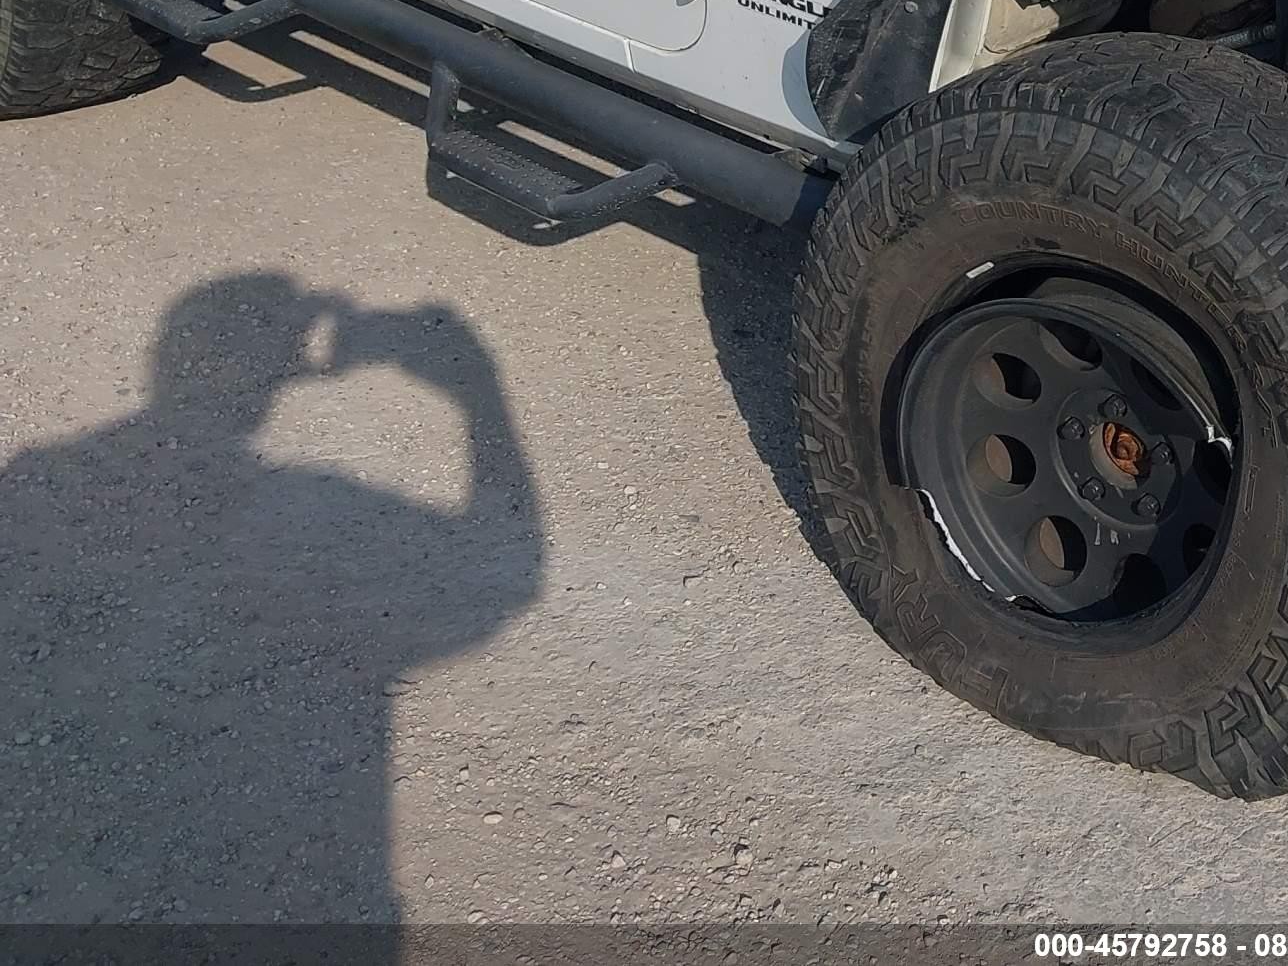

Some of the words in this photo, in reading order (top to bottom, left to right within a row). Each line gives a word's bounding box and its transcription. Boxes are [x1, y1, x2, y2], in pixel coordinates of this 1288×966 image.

[954, 200, 1108, 239] COUNTRY
[1113, 230, 1248, 354] HUNTER
[891, 564, 1009, 714] FURY
